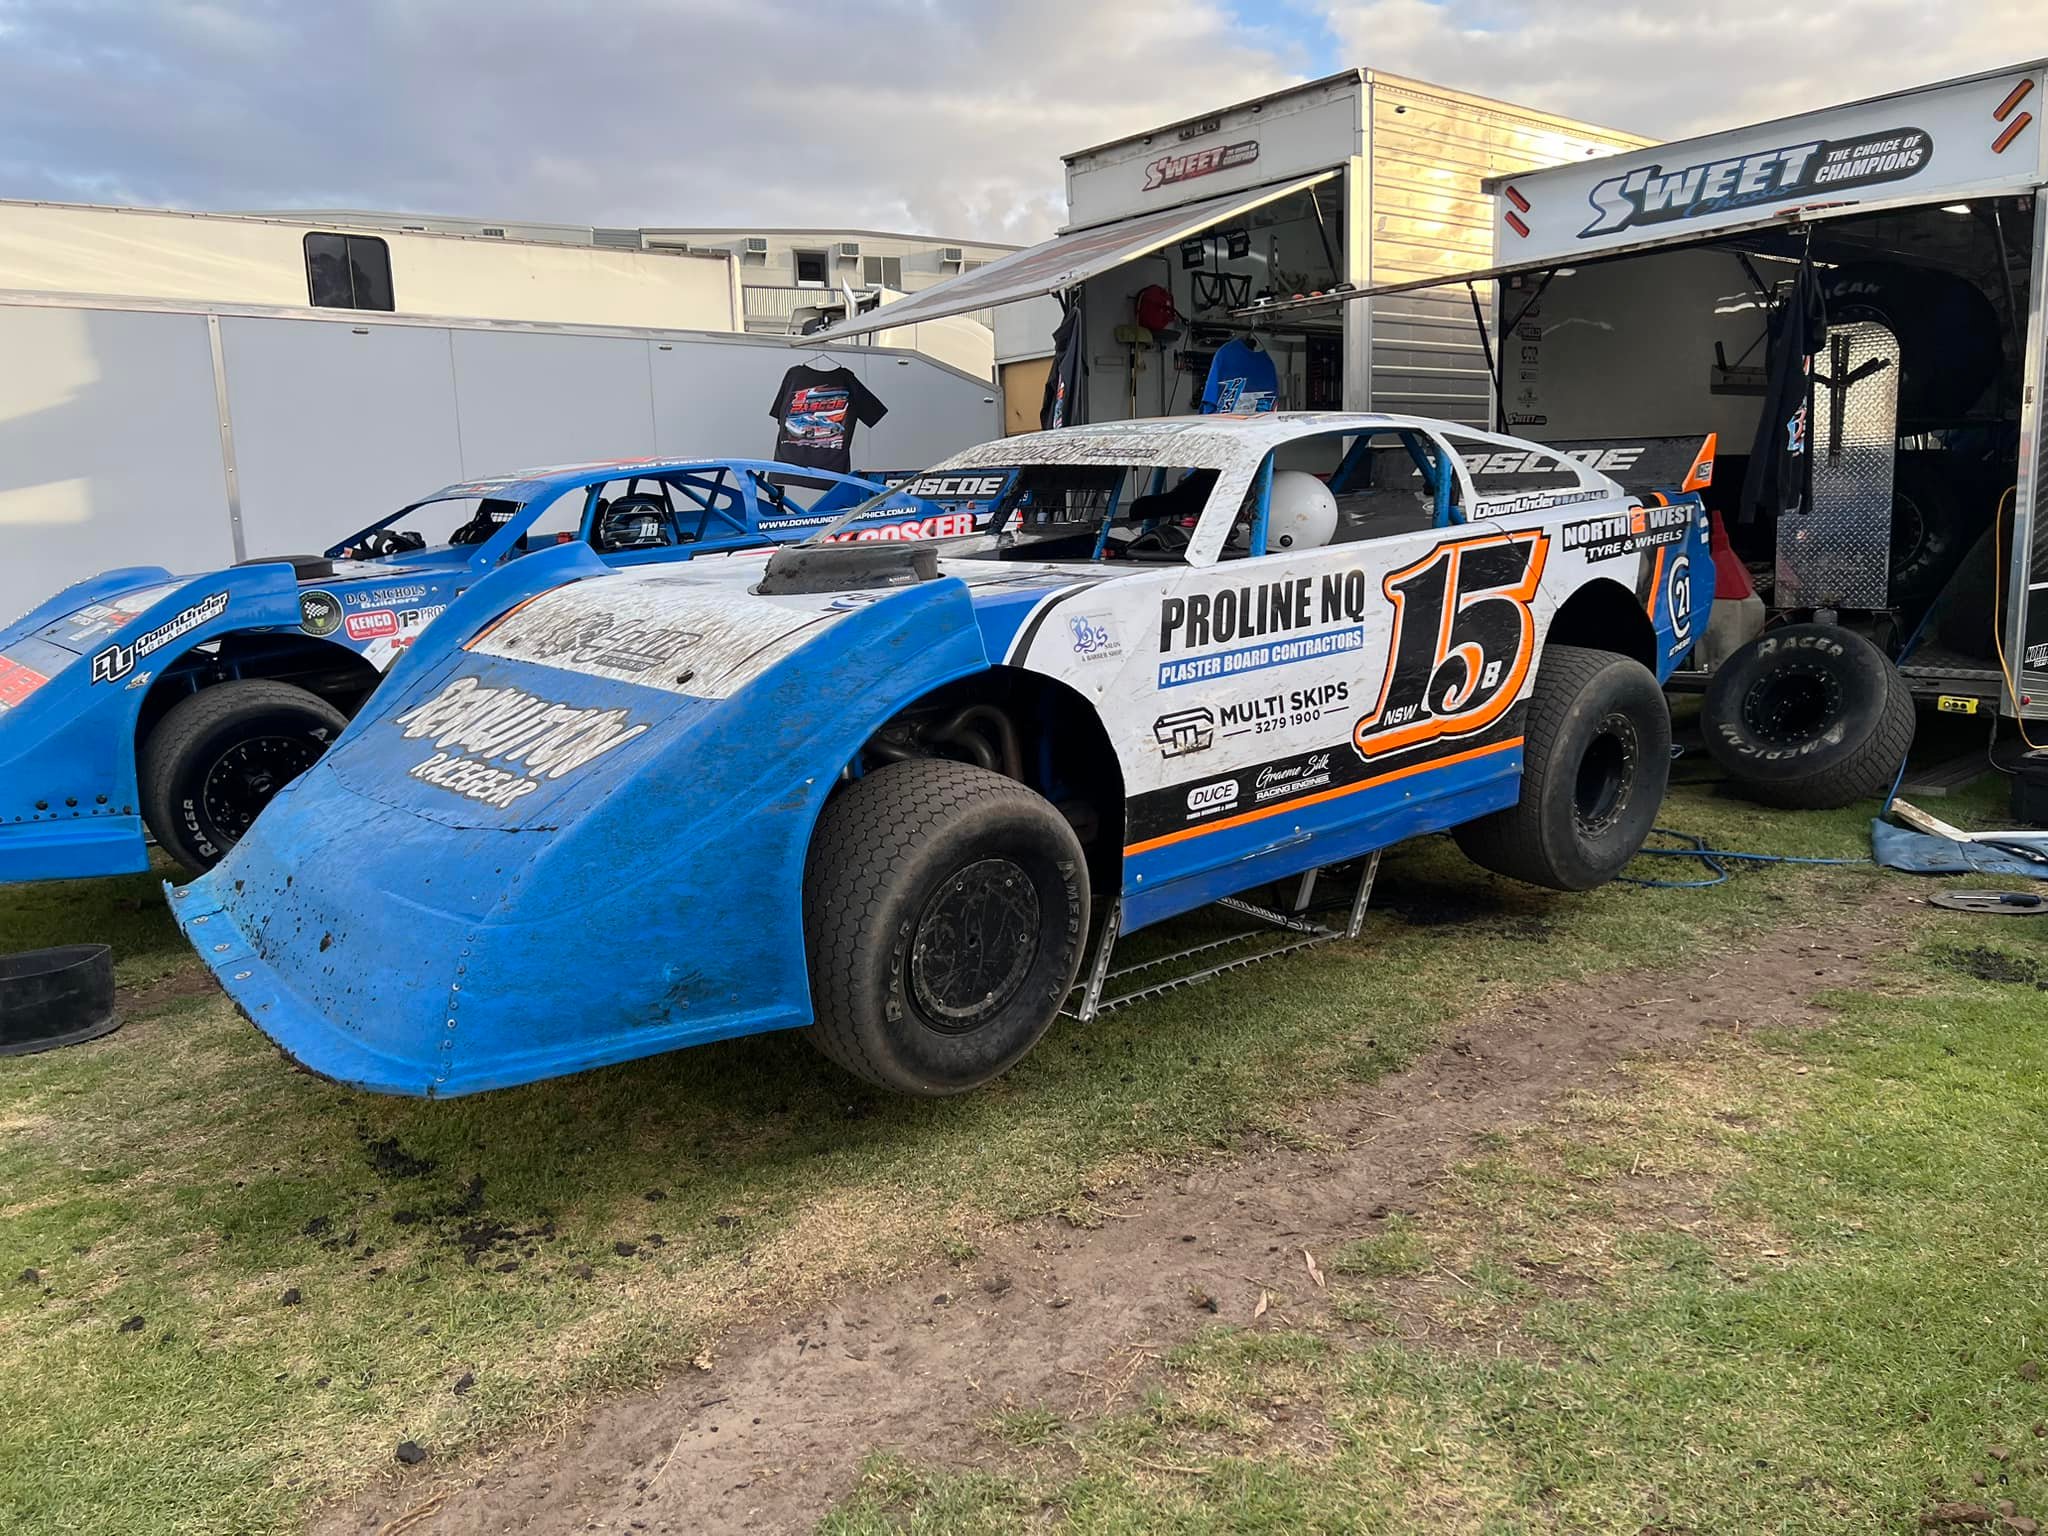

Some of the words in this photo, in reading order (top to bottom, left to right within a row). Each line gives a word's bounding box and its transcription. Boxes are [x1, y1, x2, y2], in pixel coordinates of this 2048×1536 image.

[1827, 149, 1851, 162] THE
[1854, 141, 1900, 157] CHOICE
[1903, 135, 1921, 148] OF
[1142, 145, 1226, 191] SWEET
[1815, 149, 1923, 184] CHAMPIONS
[1577, 144, 1818, 238] SWEET
[640, 523, 659, 537] 18
[1563, 518, 1627, 547] NORTH
[1630, 507, 1645, 534] 2
[1649, 505, 1694, 528] WEST
[1588, 542, 1622, 559] TYRE
[1624, 539, 1634, 551] &
[1635, 529, 1683, 549] WHEELS
[373, 585, 426, 601] NICHOLS
[1675, 576, 1690, 619] 21
[350, 614, 392, 631] KENCO
[1160, 576, 1312, 652] PROLINE
[1321, 569, 1365, 623] NQ
[1161, 659, 1220, 684] PLASTER
[1223, 648, 1269, 674] BOARD
[1271, 632, 1362, 664] CONTRACTORS
[1354, 528, 1552, 757] 15
[1758, 637, 1844, 657] RACER
[1481, 661, 1501, 689] B
[1221, 697, 1284, 727] MULTI
[1291, 681, 1349, 711] SKIPS
[1383, 704, 1418, 726] NSW
[1255, 718, 1287, 734] 3279
[1290, 709, 1321, 725] 1900
[408, 751, 538, 809] RACEGEAR
[1256, 764, 1301, 788] Graeme
[1302, 754, 1330, 777] Silk
[1256, 785, 1291, 800] RACING
[1291, 775, 1330, 790] ENGINES
[1193, 783, 1234, 805] DUCE
[184, 799, 218, 857] RACER
